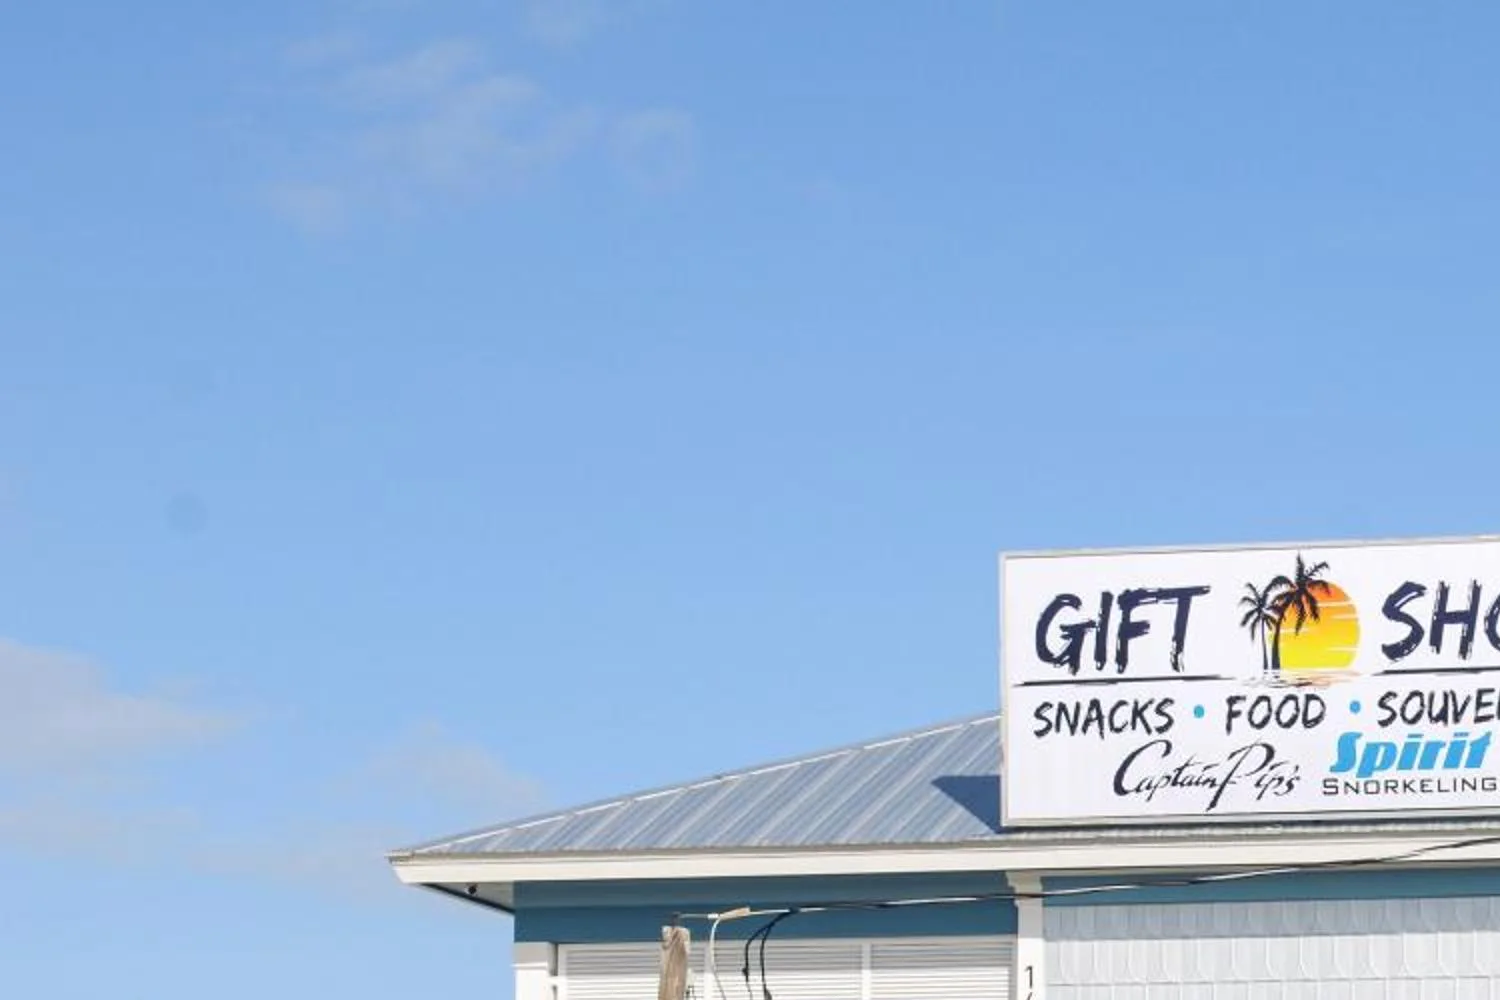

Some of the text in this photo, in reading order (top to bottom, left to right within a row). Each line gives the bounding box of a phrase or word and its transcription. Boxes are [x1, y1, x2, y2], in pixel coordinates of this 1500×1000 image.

[1034, 585, 1211, 674] GIFT
[1033, 697, 1175, 738] SNACKS
[1225, 693, 1327, 732] FOOD
[1113, 739, 1222, 802] Captain
[1329, 731, 1493, 778] Spirit
[1322, 777, 1498, 796] SNORKELING
